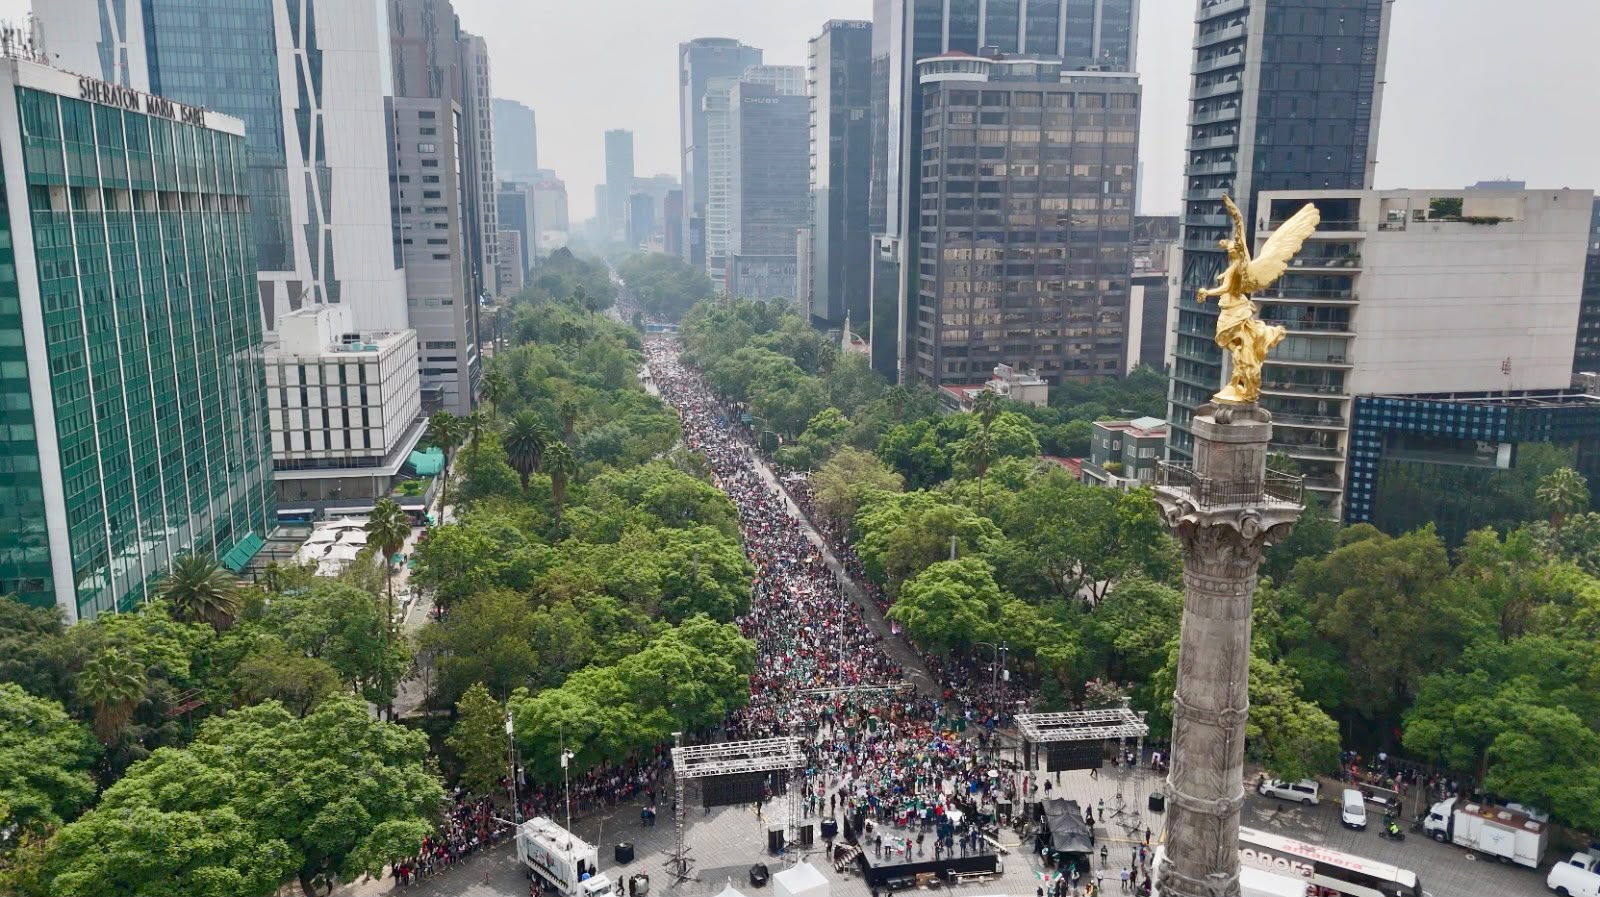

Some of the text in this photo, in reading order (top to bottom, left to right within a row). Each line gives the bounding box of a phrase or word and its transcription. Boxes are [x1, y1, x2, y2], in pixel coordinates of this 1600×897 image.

[79, 78, 206, 127] SHERATON MARIA ISABEL
[1238, 848, 1315, 880] onora
